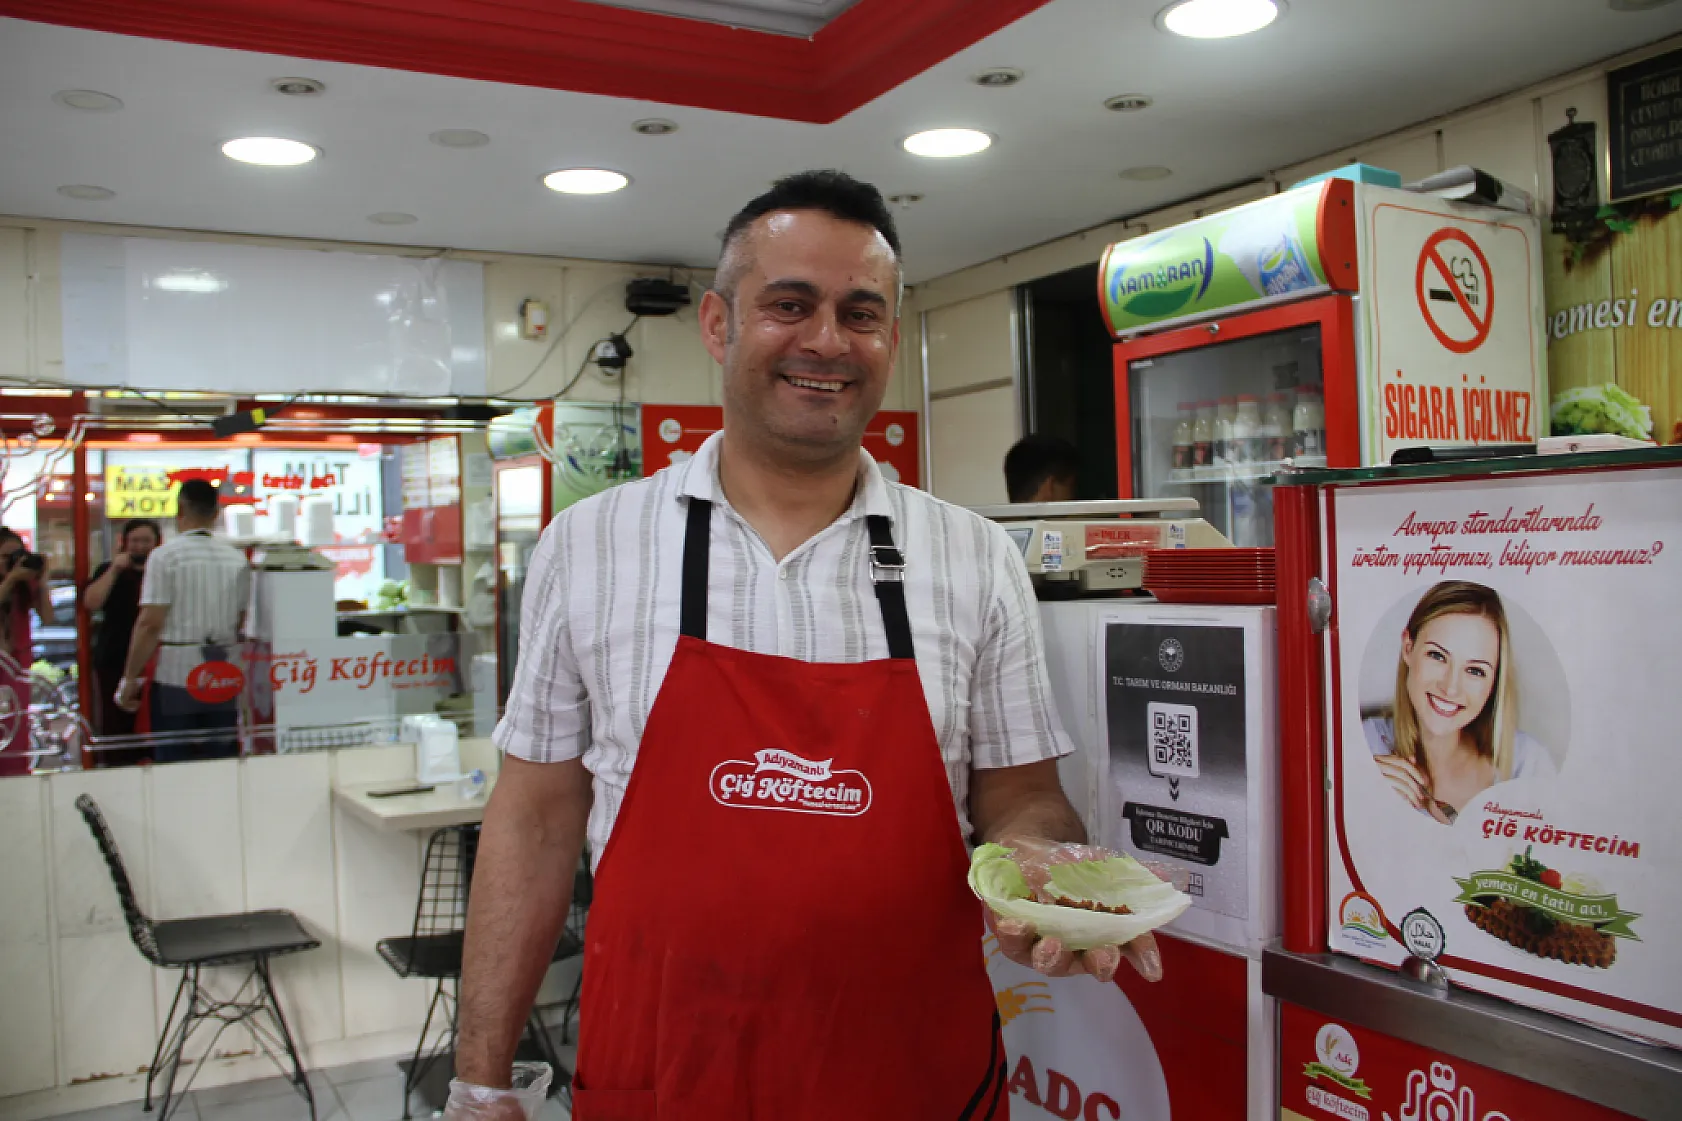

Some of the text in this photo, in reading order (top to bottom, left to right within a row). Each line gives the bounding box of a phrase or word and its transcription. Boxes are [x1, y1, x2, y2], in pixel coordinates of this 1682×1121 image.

[1385, 369, 1532, 446] SİGARA İÇİLMEZ
[1392, 502, 1604, 543] Avrupa standartlarında
[1352, 543, 1400, 568] üretim
[1498, 539, 1557, 575] biliyor
[1558, 540, 1664, 566] musunuz?
[270, 652, 455, 693] Çiğ Köftecim
[720, 773, 862, 803] Çiğ Köftecim
[1145, 818, 1203, 842] QR KODU
[1481, 818, 1640, 858] ÇİĞ KÖFTECİM
[1475, 878, 1518, 895] yemesi
[1521, 888, 1537, 901] en
[1542, 893, 1575, 913] tatlı
